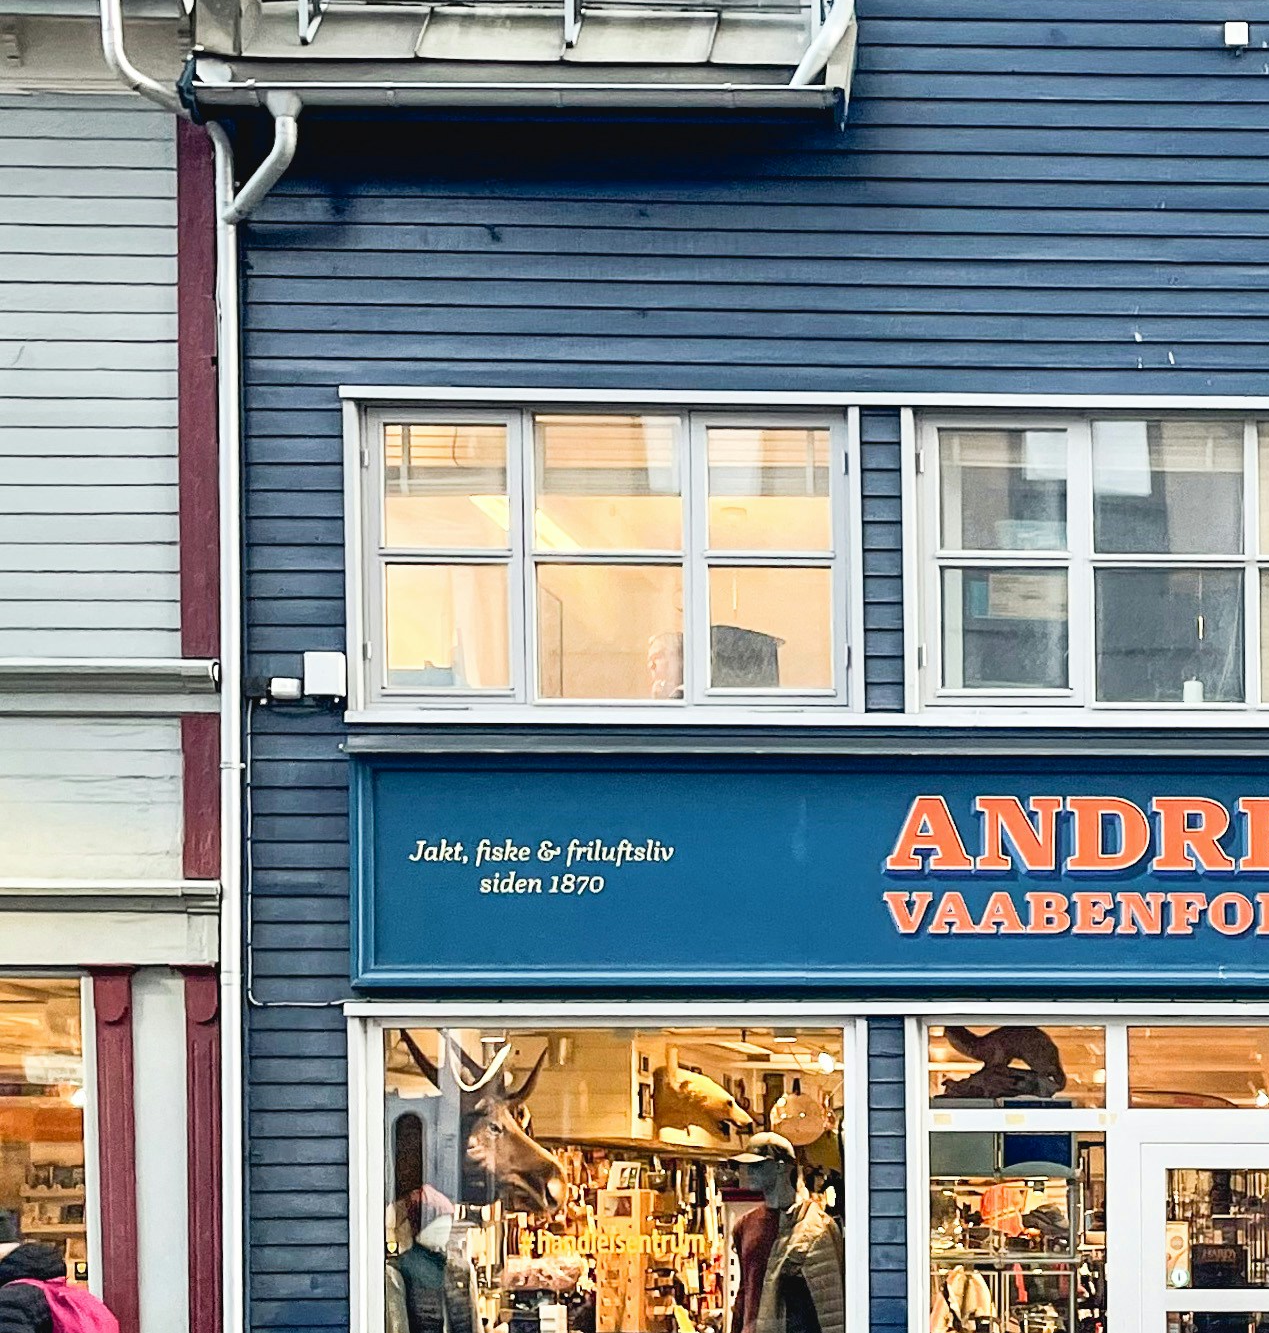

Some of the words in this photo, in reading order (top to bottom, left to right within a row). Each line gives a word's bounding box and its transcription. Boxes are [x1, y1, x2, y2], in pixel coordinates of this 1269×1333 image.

[408, 838, 469, 865] Jakt,
[474, 838, 531, 867] fiske
[537, 840, 561, 862] &
[565, 838, 674, 868] friluftsliv
[479, 870, 542, 895] siden
[548, 873, 605, 897] 1870
